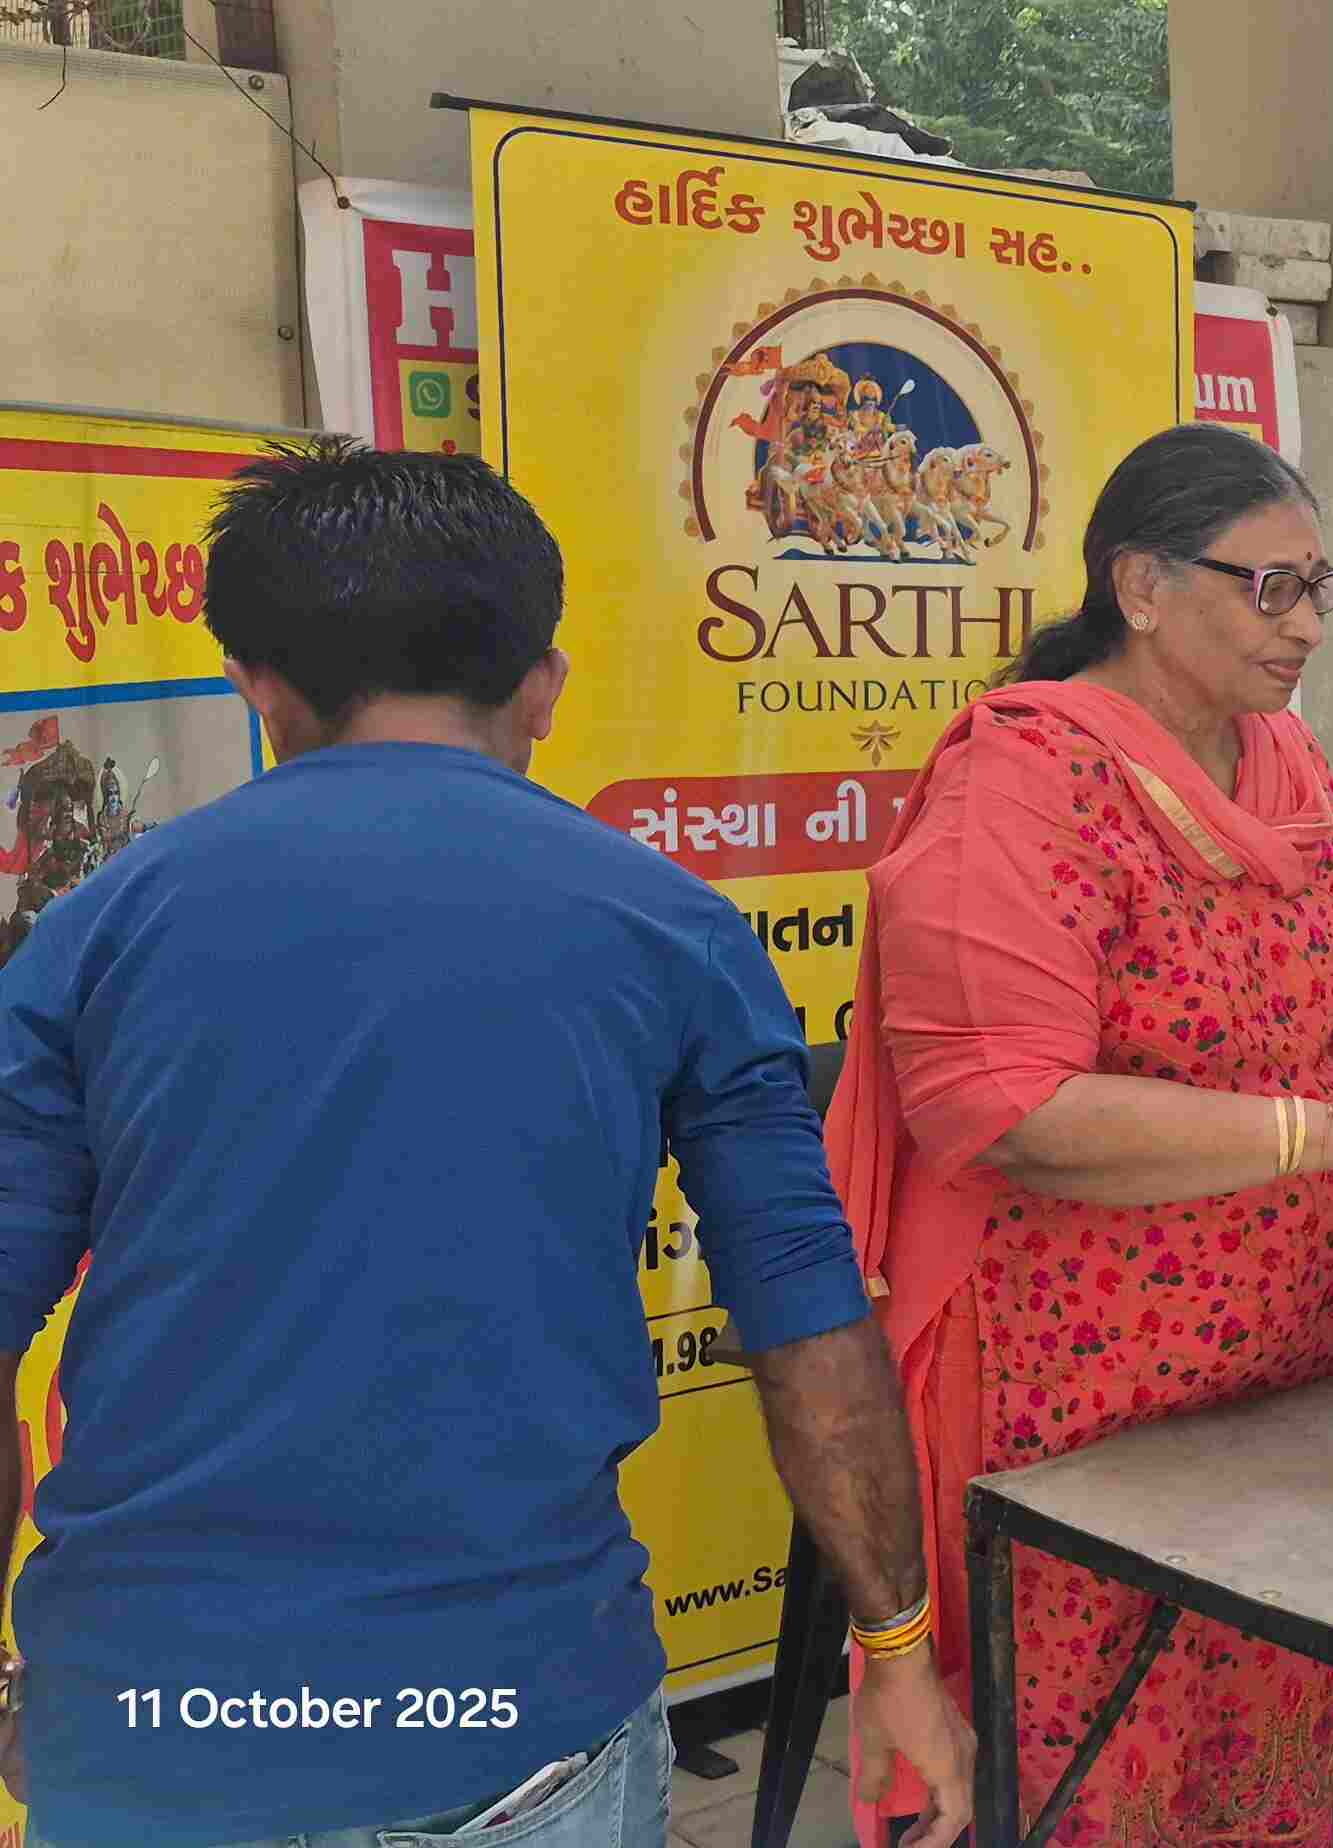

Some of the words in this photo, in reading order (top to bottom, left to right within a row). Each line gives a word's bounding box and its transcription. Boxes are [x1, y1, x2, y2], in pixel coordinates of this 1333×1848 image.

[613, 165, 767, 235] હાર્દિક
[791, 190, 967, 263] શુભેચ્છા
[44, 501, 204, 664] શુભેચ્છ
[696, 563, 1037, 663] SARTHI
[736, 679, 987, 714] FOUNDATIO
[629, 786, 777, 853] સંસ્થા
[804, 778, 868, 843] ની
